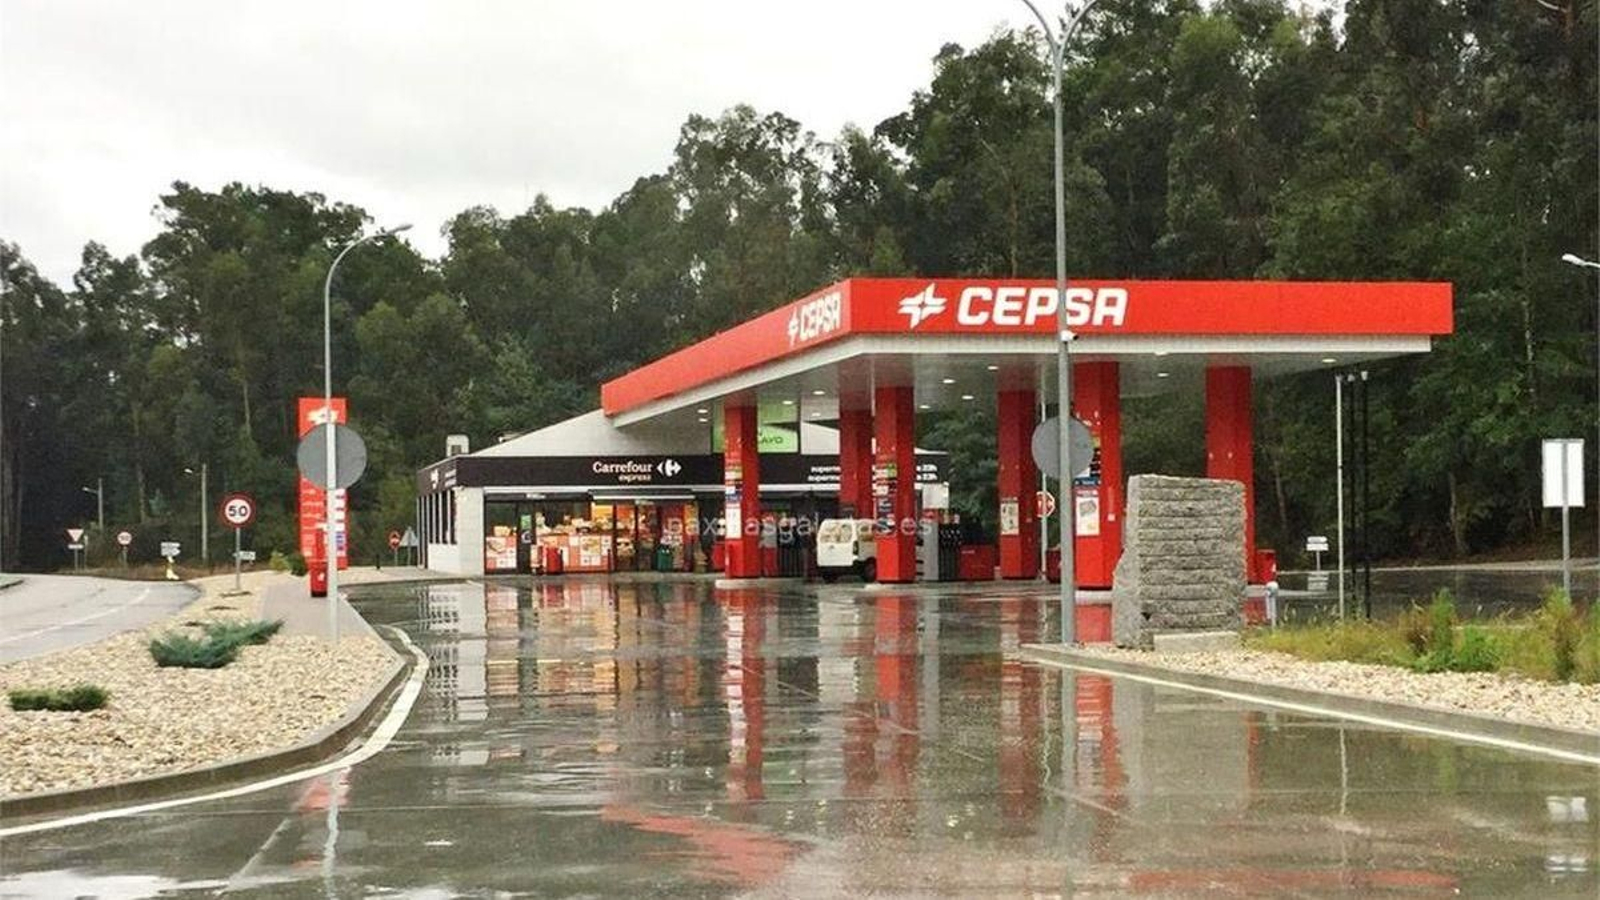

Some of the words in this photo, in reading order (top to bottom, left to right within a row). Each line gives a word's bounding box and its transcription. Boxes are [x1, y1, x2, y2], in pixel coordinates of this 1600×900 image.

[800, 293, 841, 341] CEPSA
[957, 287, 1127, 326] CEPSA
[592, 460, 653, 473] Carrefour
[228, 505, 248, 517] 50
